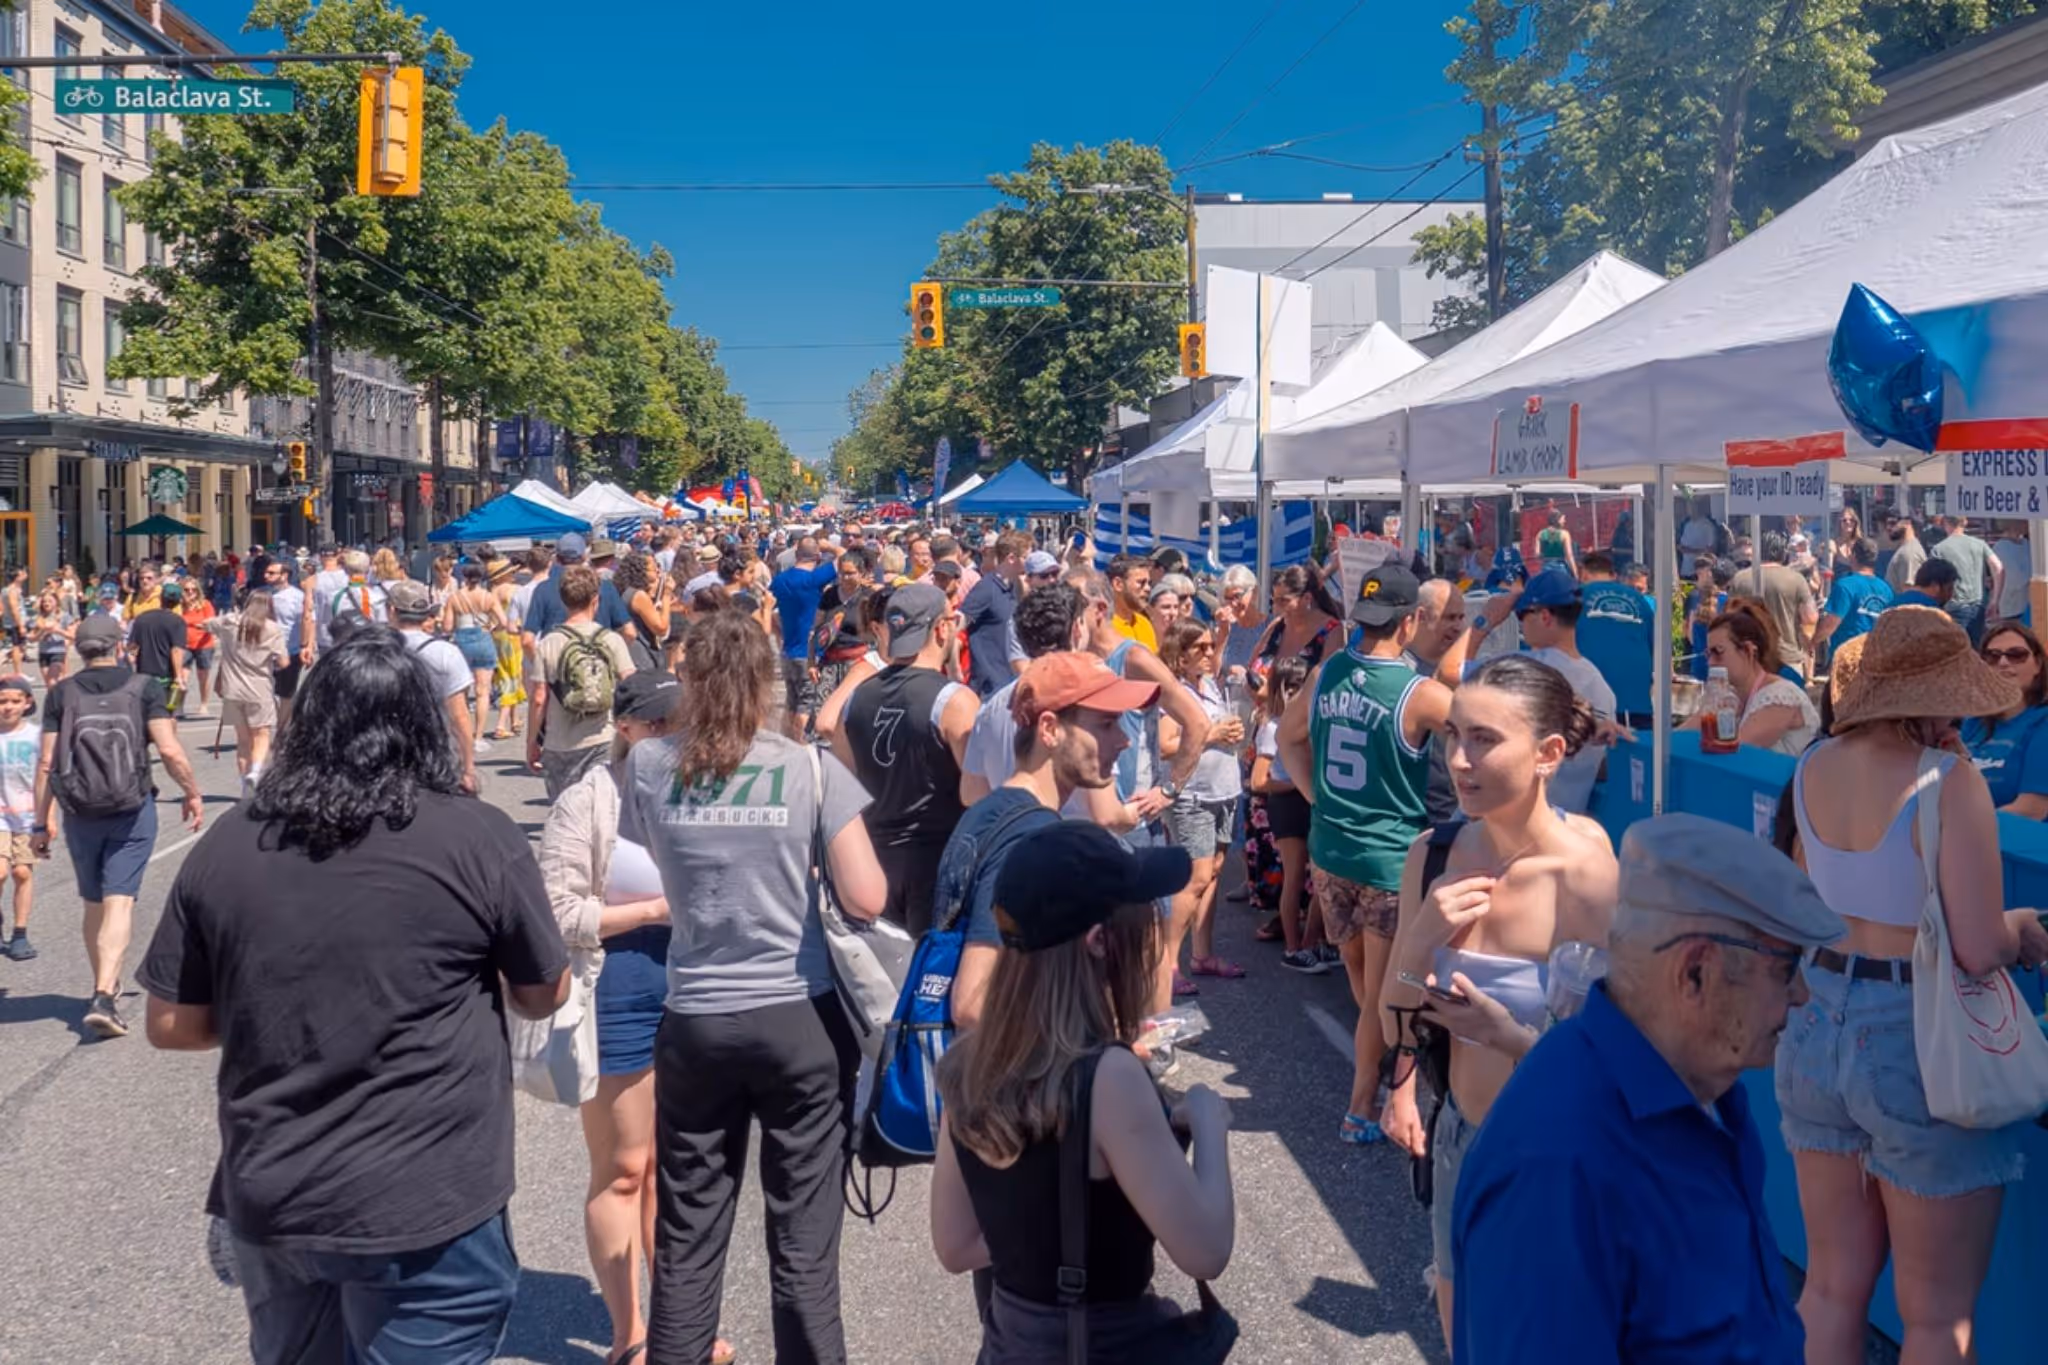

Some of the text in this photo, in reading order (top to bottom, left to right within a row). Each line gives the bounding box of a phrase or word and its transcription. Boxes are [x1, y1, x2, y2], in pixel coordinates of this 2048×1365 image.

[115, 86, 271, 108] Balaclava St.
[978, 292, 1049, 304] Balaclava St.
[1962, 449, 2038, 477] EXPRESS
[1731, 470, 1825, 502] Have your ID ready
[1957, 484, 2040, 512] for Beer &
[1363, 579, 1381, 600] P
[1319, 691, 1391, 731] GARNETT
[872, 706, 905, 767] 7
[1326, 724, 1367, 791] 5
